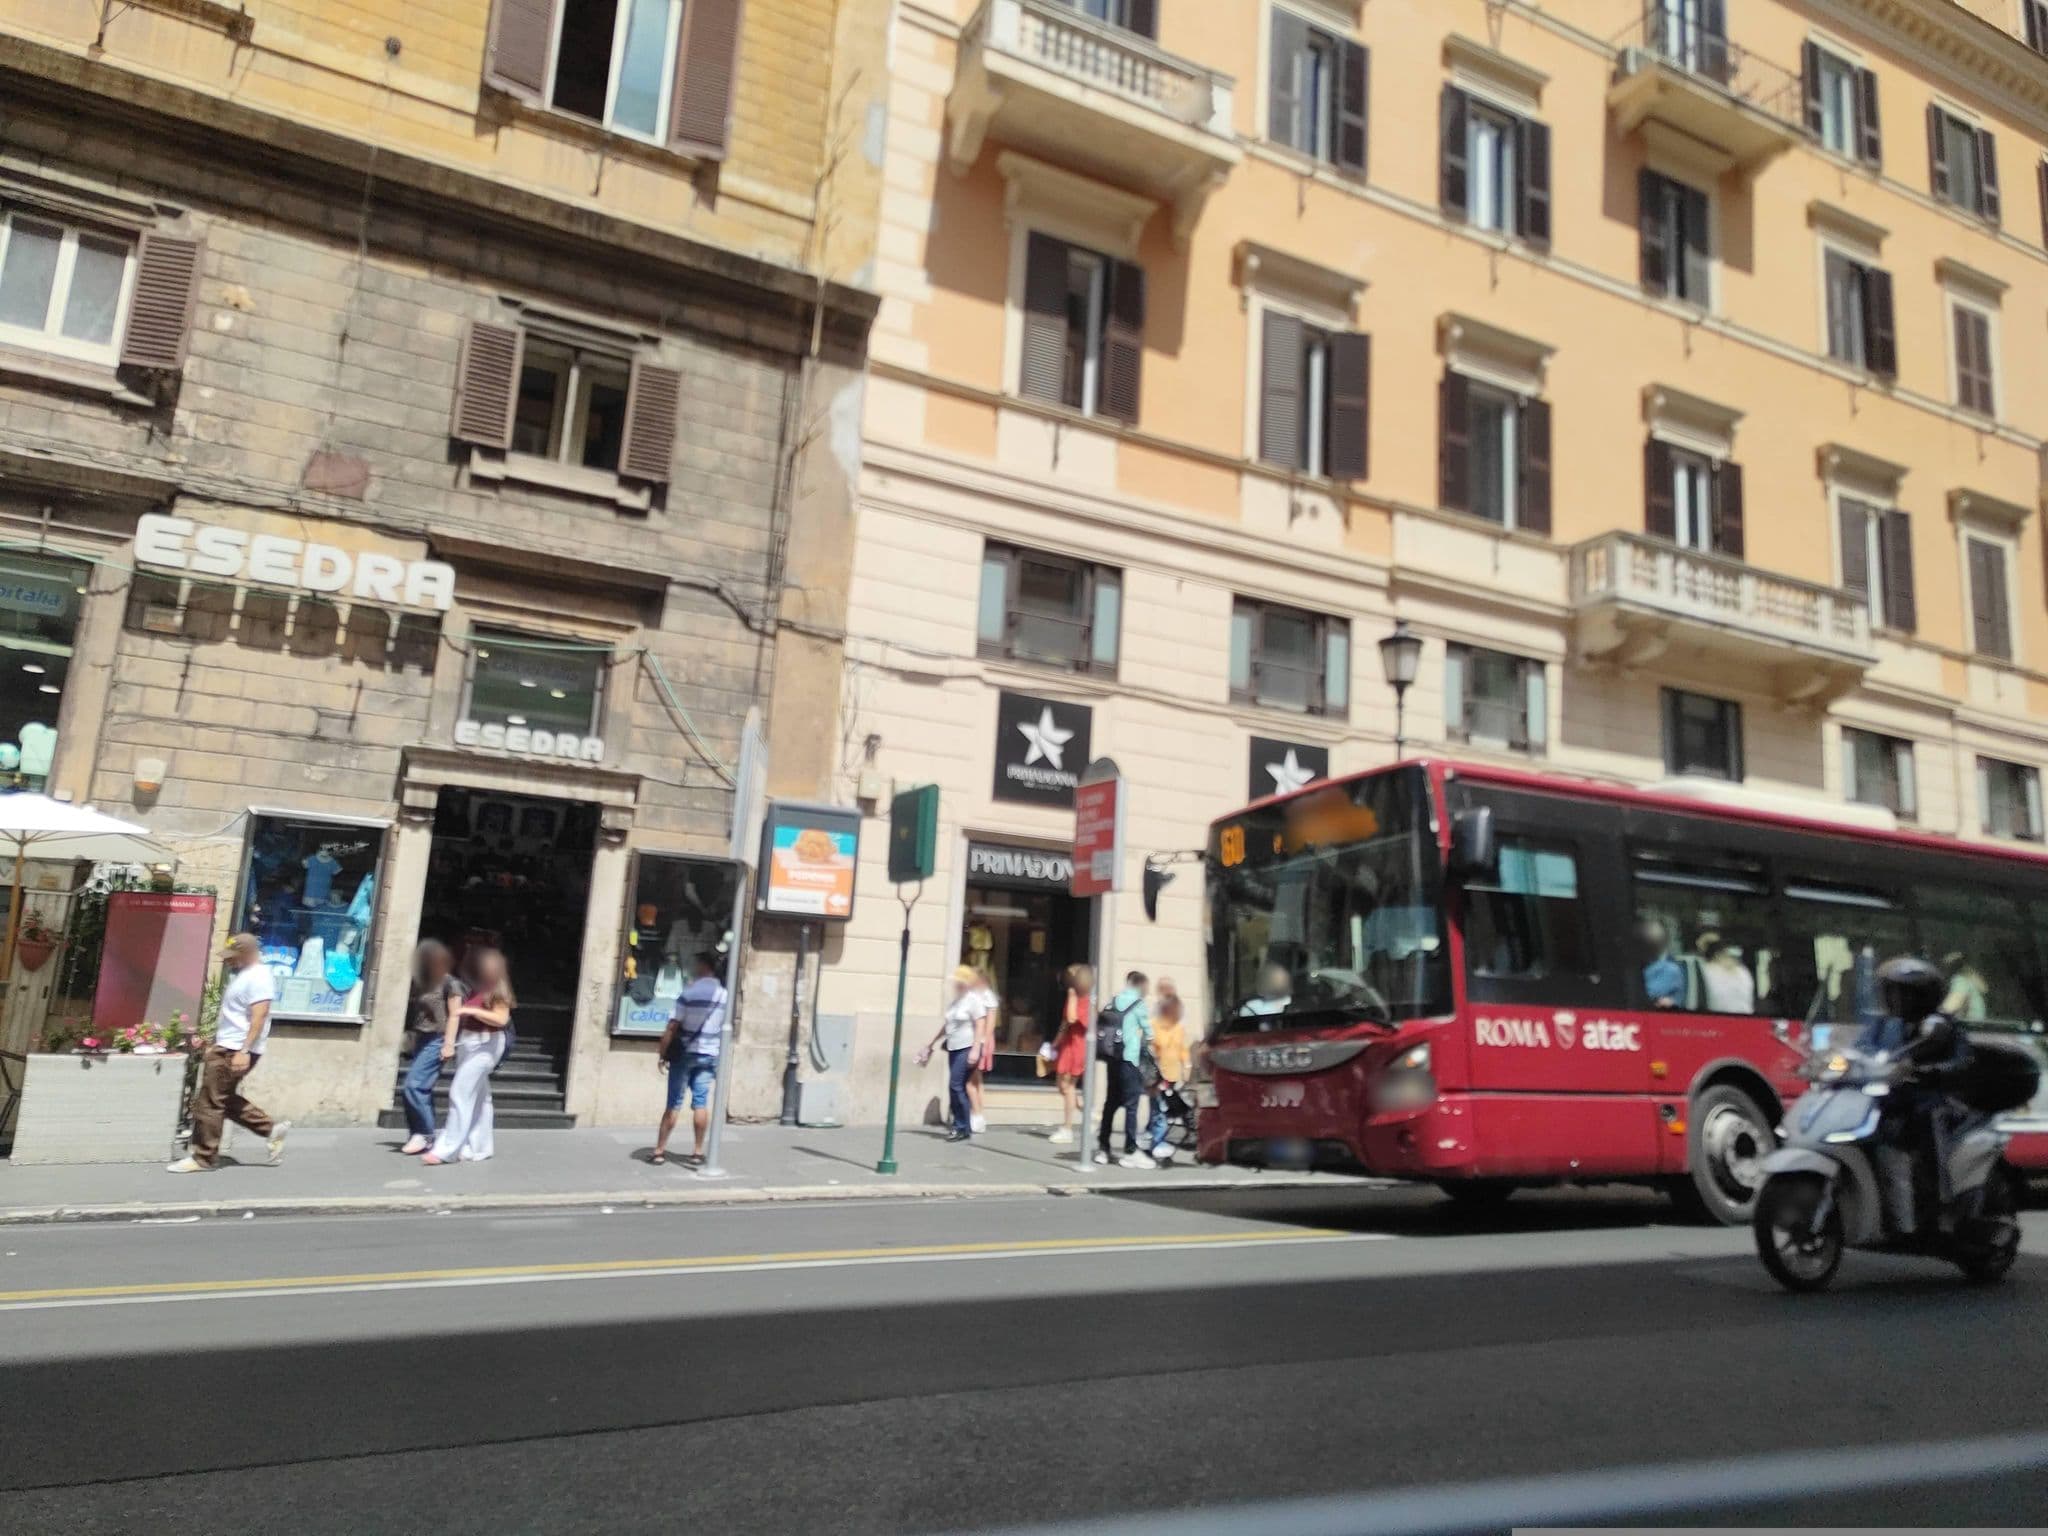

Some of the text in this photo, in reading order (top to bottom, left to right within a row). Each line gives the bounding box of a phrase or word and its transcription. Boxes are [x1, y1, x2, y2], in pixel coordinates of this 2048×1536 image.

[134, 513, 455, 611] ESEDRA
[455, 720, 605, 762] ESEDRA
[1475, 1017, 1550, 1048] ROMA
[1582, 1018, 1642, 1051] atac
